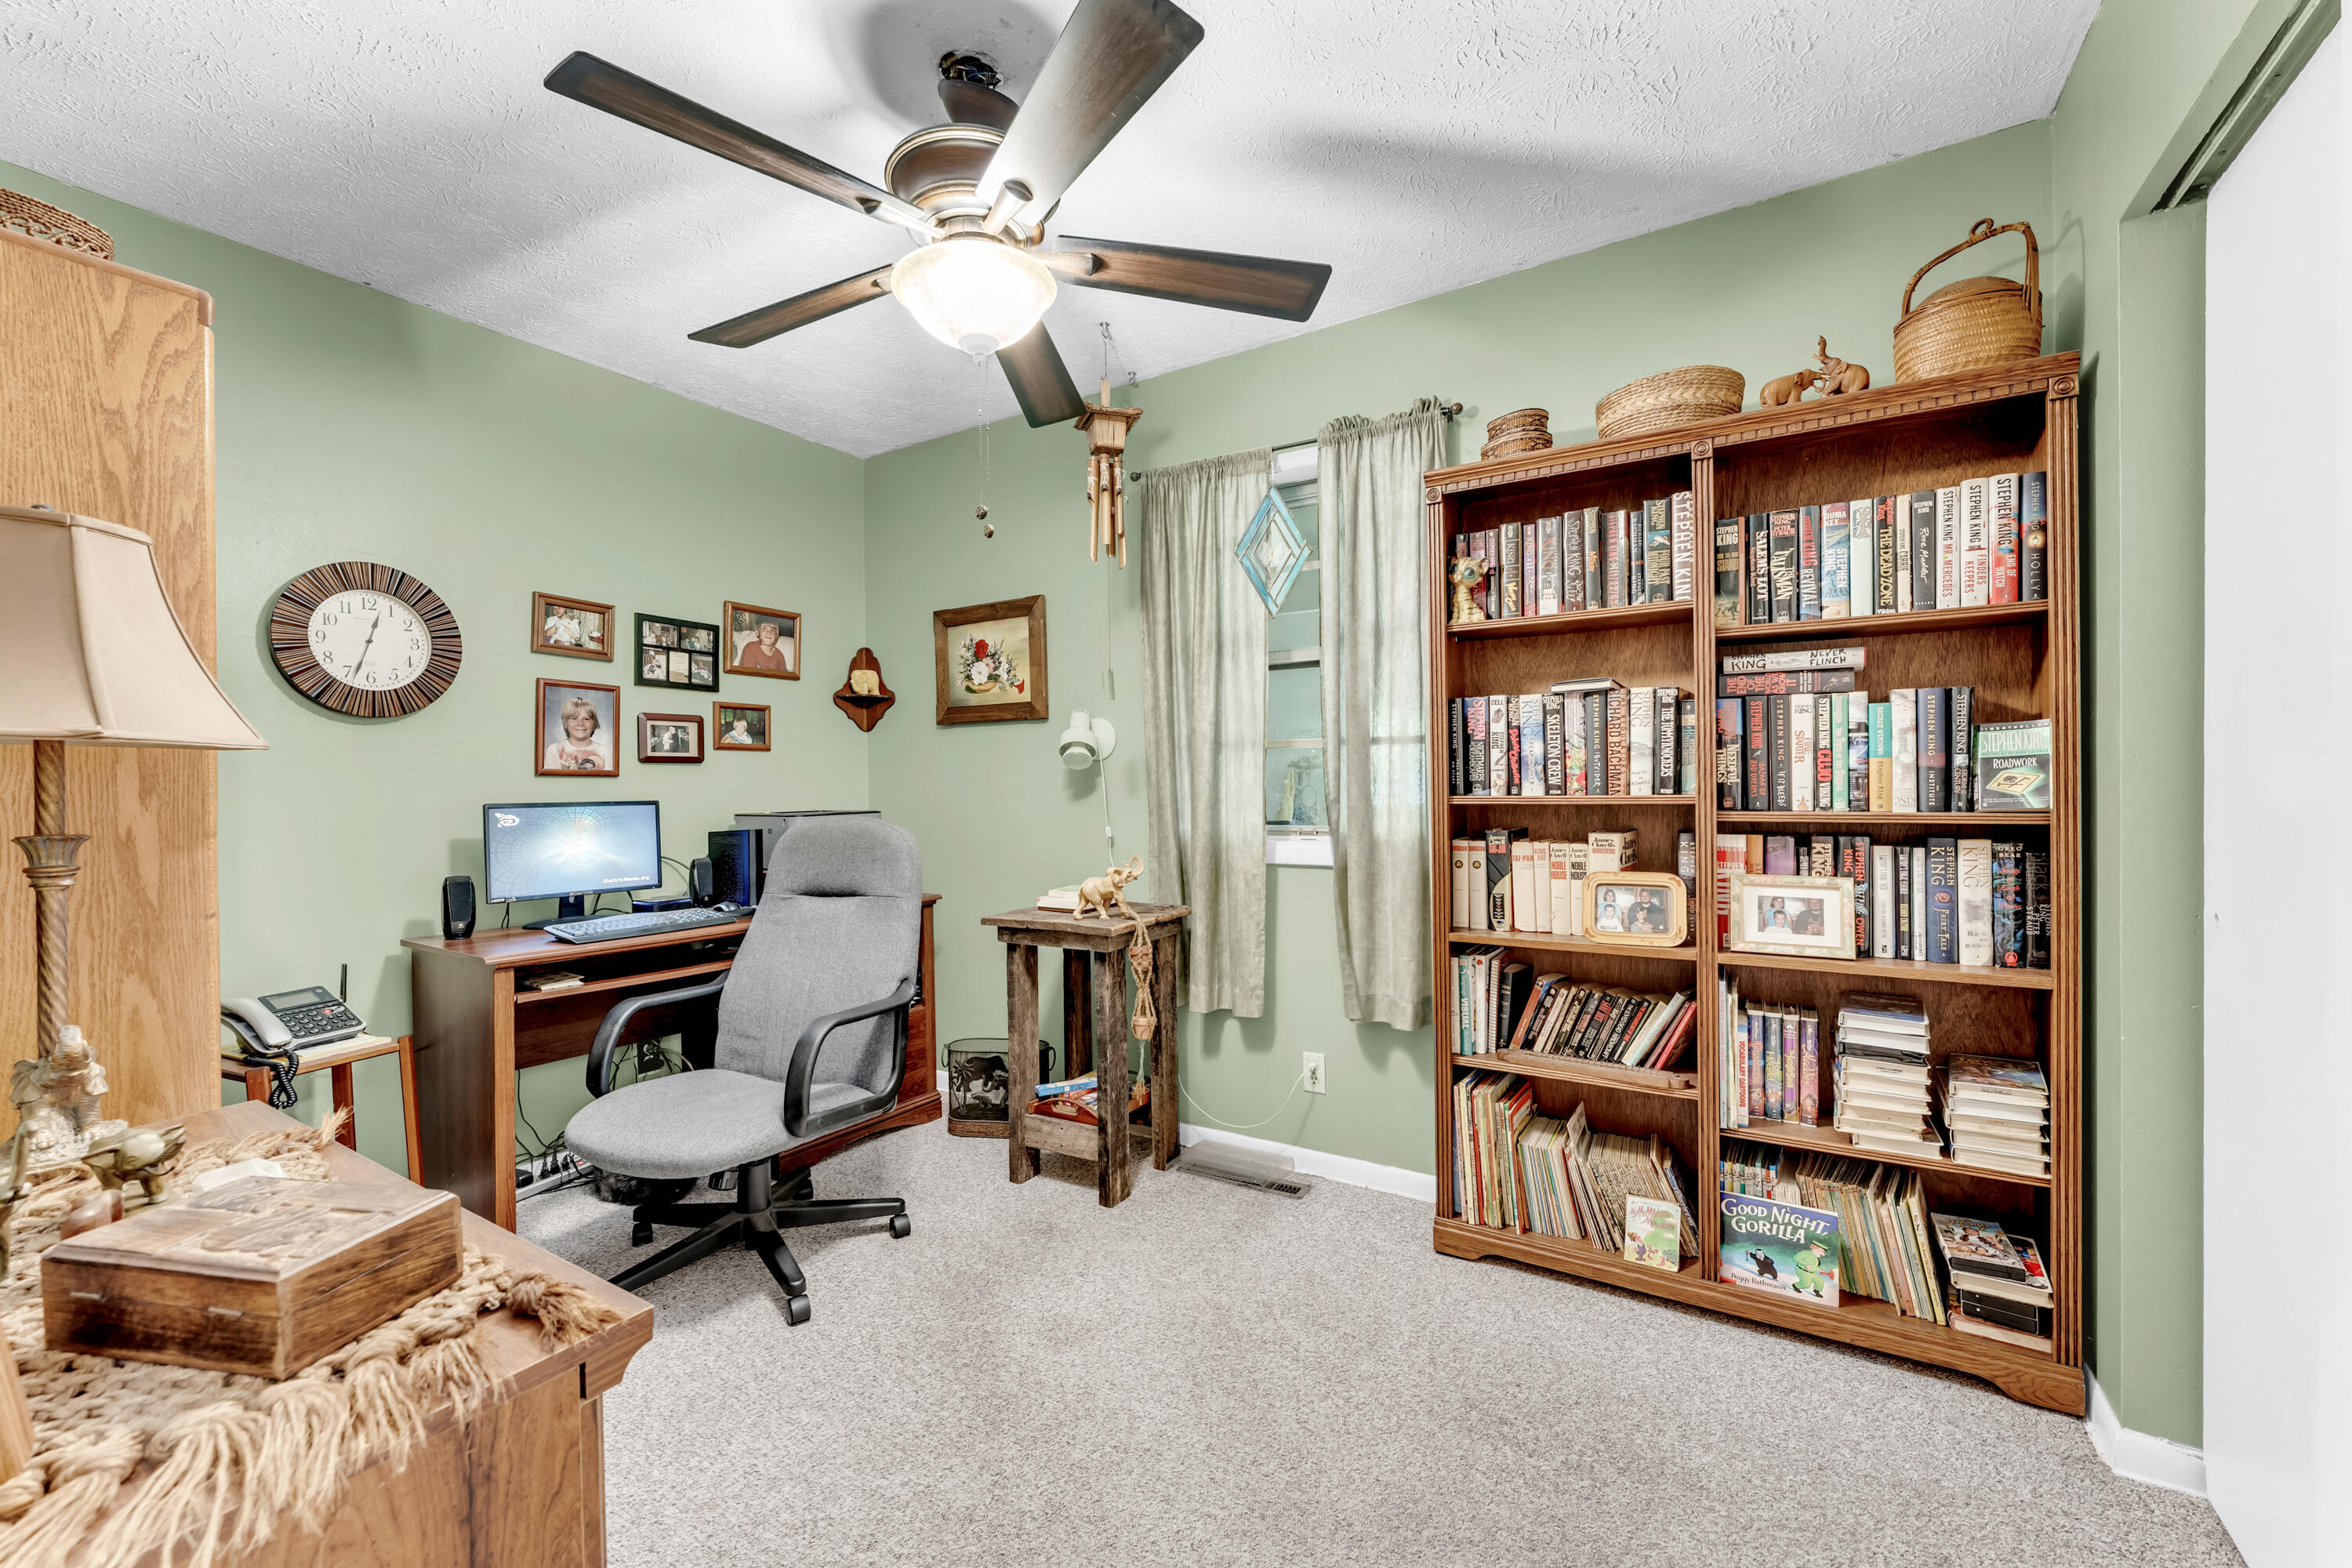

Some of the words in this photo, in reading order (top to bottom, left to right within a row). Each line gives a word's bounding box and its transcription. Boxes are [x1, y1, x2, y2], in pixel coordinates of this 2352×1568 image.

[1969, 485, 1981, 520] STEPHEN
[1998, 478, 2012, 519] STEPHEN
[1656, 500, 1665, 530] STEPHEN
[1877, 505, 1886, 521] King
[1885, 498, 1894, 524] Stephen
[1568, 520, 1581, 550] STEPHEN
[1609, 514, 1618, 542] STEPHEN
[1716, 525, 1738, 535] STEPHEN
[1717, 533, 1739, 546] KING
[1805, 516, 1813, 541] STEPHEN
[1880, 527, 1893, 547] THE
[1919, 528, 1929, 549] Rose
[1969, 524, 1981, 543] KING
[1998, 523, 2012, 546] KING
[1568, 553, 1581, 575] KING
[1609, 544, 1618, 561] KING
[1659, 549, 1670, 568] FOUR
[1802, 543, 1817, 566] KING
[1825, 550, 1836, 572] KING
[1880, 549, 1893, 576] DEAD
[2007, 555, 2016, 568] END
[1648, 550, 1659, 585] MIDNIGHT
[1659, 569, 1670, 585] PAST
[1770, 548, 1795, 601] TALISMAN
[1836, 549, 1847, 588] STEPHEN
[1919, 550, 1929, 583] Madder
[1965, 561, 1974, 593] KEEPERS
[1977, 554, 1987, 585] FINDERS
[1994, 566, 2005, 588] WATCH
[2007, 569, 2016, 579] OF
[2031, 554, 2040, 592] HOLLY
[1800, 569, 1817, 608] REVIVAL
[1880, 578, 1893, 607] ZONE
[340, 601, 351, 614] 11
[361, 597, 377, 611] 12
[389, 605, 394, 618] 1
[321, 613, 337, 626] 10
[403, 619, 412, 632] 2
[315, 630, 326, 643] 9
[410, 638, 419, 651] 3
[323, 651, 332, 665] 8
[403, 655, 412, 668] 4
[1732, 659, 1766, 671] KING
[1809, 657, 1846, 666] FLINCH
[1810, 648, 1846, 659] NEVER
[343, 665, 351, 677] 7
[365, 671, 376, 684] 6
[389, 668, 398, 682] 5
[1726, 677, 1737, 693] THE
[1737, 676, 1747, 695] END
[1747, 679, 1755, 690] OF
[1755, 676, 1765, 692] THE
[1474, 700, 1486, 740] STEPHEN
[1522, 701, 1534, 737] KING
[1532, 699, 1541, 737] STEPHEN
[1609, 690, 1621, 737] RICHARD
[1631, 691, 1642, 728] KING
[1662, 707, 1674, 721] THE
[1750, 701, 1762, 731] STEPHEN
[1819, 698, 1831, 729] STEPHEN
[1957, 695, 1967, 729] STEPHEN
[1546, 713, 1560, 757] SKELETON
[1751, 732, 1762, 750] KING
[1819, 730, 1831, 749] KING
[1957, 732, 1966, 753] KING
[1982, 731, 2022, 753] STEPHEN
[2023, 729, 2048, 750] KING
[1661, 722, 1673, 776] TOMMYKNOCKERS
[1795, 731, 1805, 764] STARTER
[1475, 742, 1485, 781] NIGHTMARES
[1548, 759, 1561, 786] CREW
[1609, 742, 1621, 795] BACHMAN
[1717, 748, 1728, 782] THINGS
[1726, 744, 1740, 785] NEEDFUL
[1817, 750, 1833, 782] CUJO
[1993, 757, 2038, 769] ROADWORK
[1819, 782, 1830, 808] VIKING
[1551, 861, 1566, 870] NOBLE
[1571, 861, 1587, 870] NOBLE
[1680, 841, 1689, 873] KING
[1812, 843, 1824, 877] KING
[1844, 848, 1853, 872] KING
[1855, 841, 1864, 881] STEPHEN
[1930, 847, 1945, 886] KING
[1947, 847, 1955, 885] STEPHEN
[1963, 847, 1979, 887] KING
[1979, 847, 1989, 887] STEPHEN
[1551, 870, 1567, 880] HOUSE
[2035, 853, 2049, 891] Black
[1855, 883, 1865, 914] SLEEPING
[1856, 917, 1864, 946] OWEN
[1614, 1021, 1624, 1033] DEAD
[1620, 1010, 1630, 1023] LOVED
[1601, 1037, 1617, 1058] LOVECRAFT
[1802, 1044, 1817, 1085] Aladdin
[1787, 1073, 1795, 1089] Book
[1720, 1198, 1767, 1217] GOOD
[1730, 1216, 1805, 1244] GORILLA
[1731, 1272, 1750, 1285] Peggy
[1751, 1276, 1786, 1291] Rathmann
